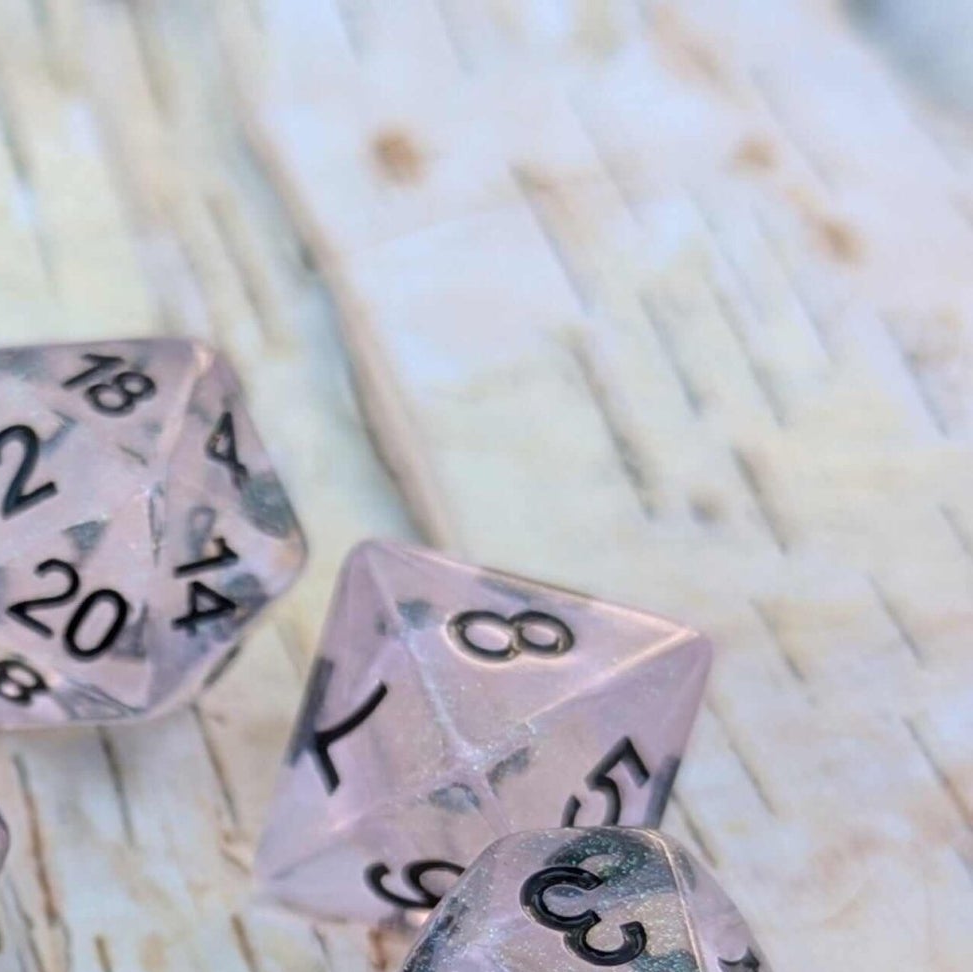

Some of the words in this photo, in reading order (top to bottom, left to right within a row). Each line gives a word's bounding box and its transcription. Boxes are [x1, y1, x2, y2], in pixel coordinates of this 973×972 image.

[61, 352, 157, 418] 18
[204, 411, 250, 491] 4
[5, 557, 130, 661] 20
[171, 535, 241, 637] 14
[447, 609, 576, 663] 8
[562, 735, 651, 828] 5
[519, 866, 647, 967] 3
